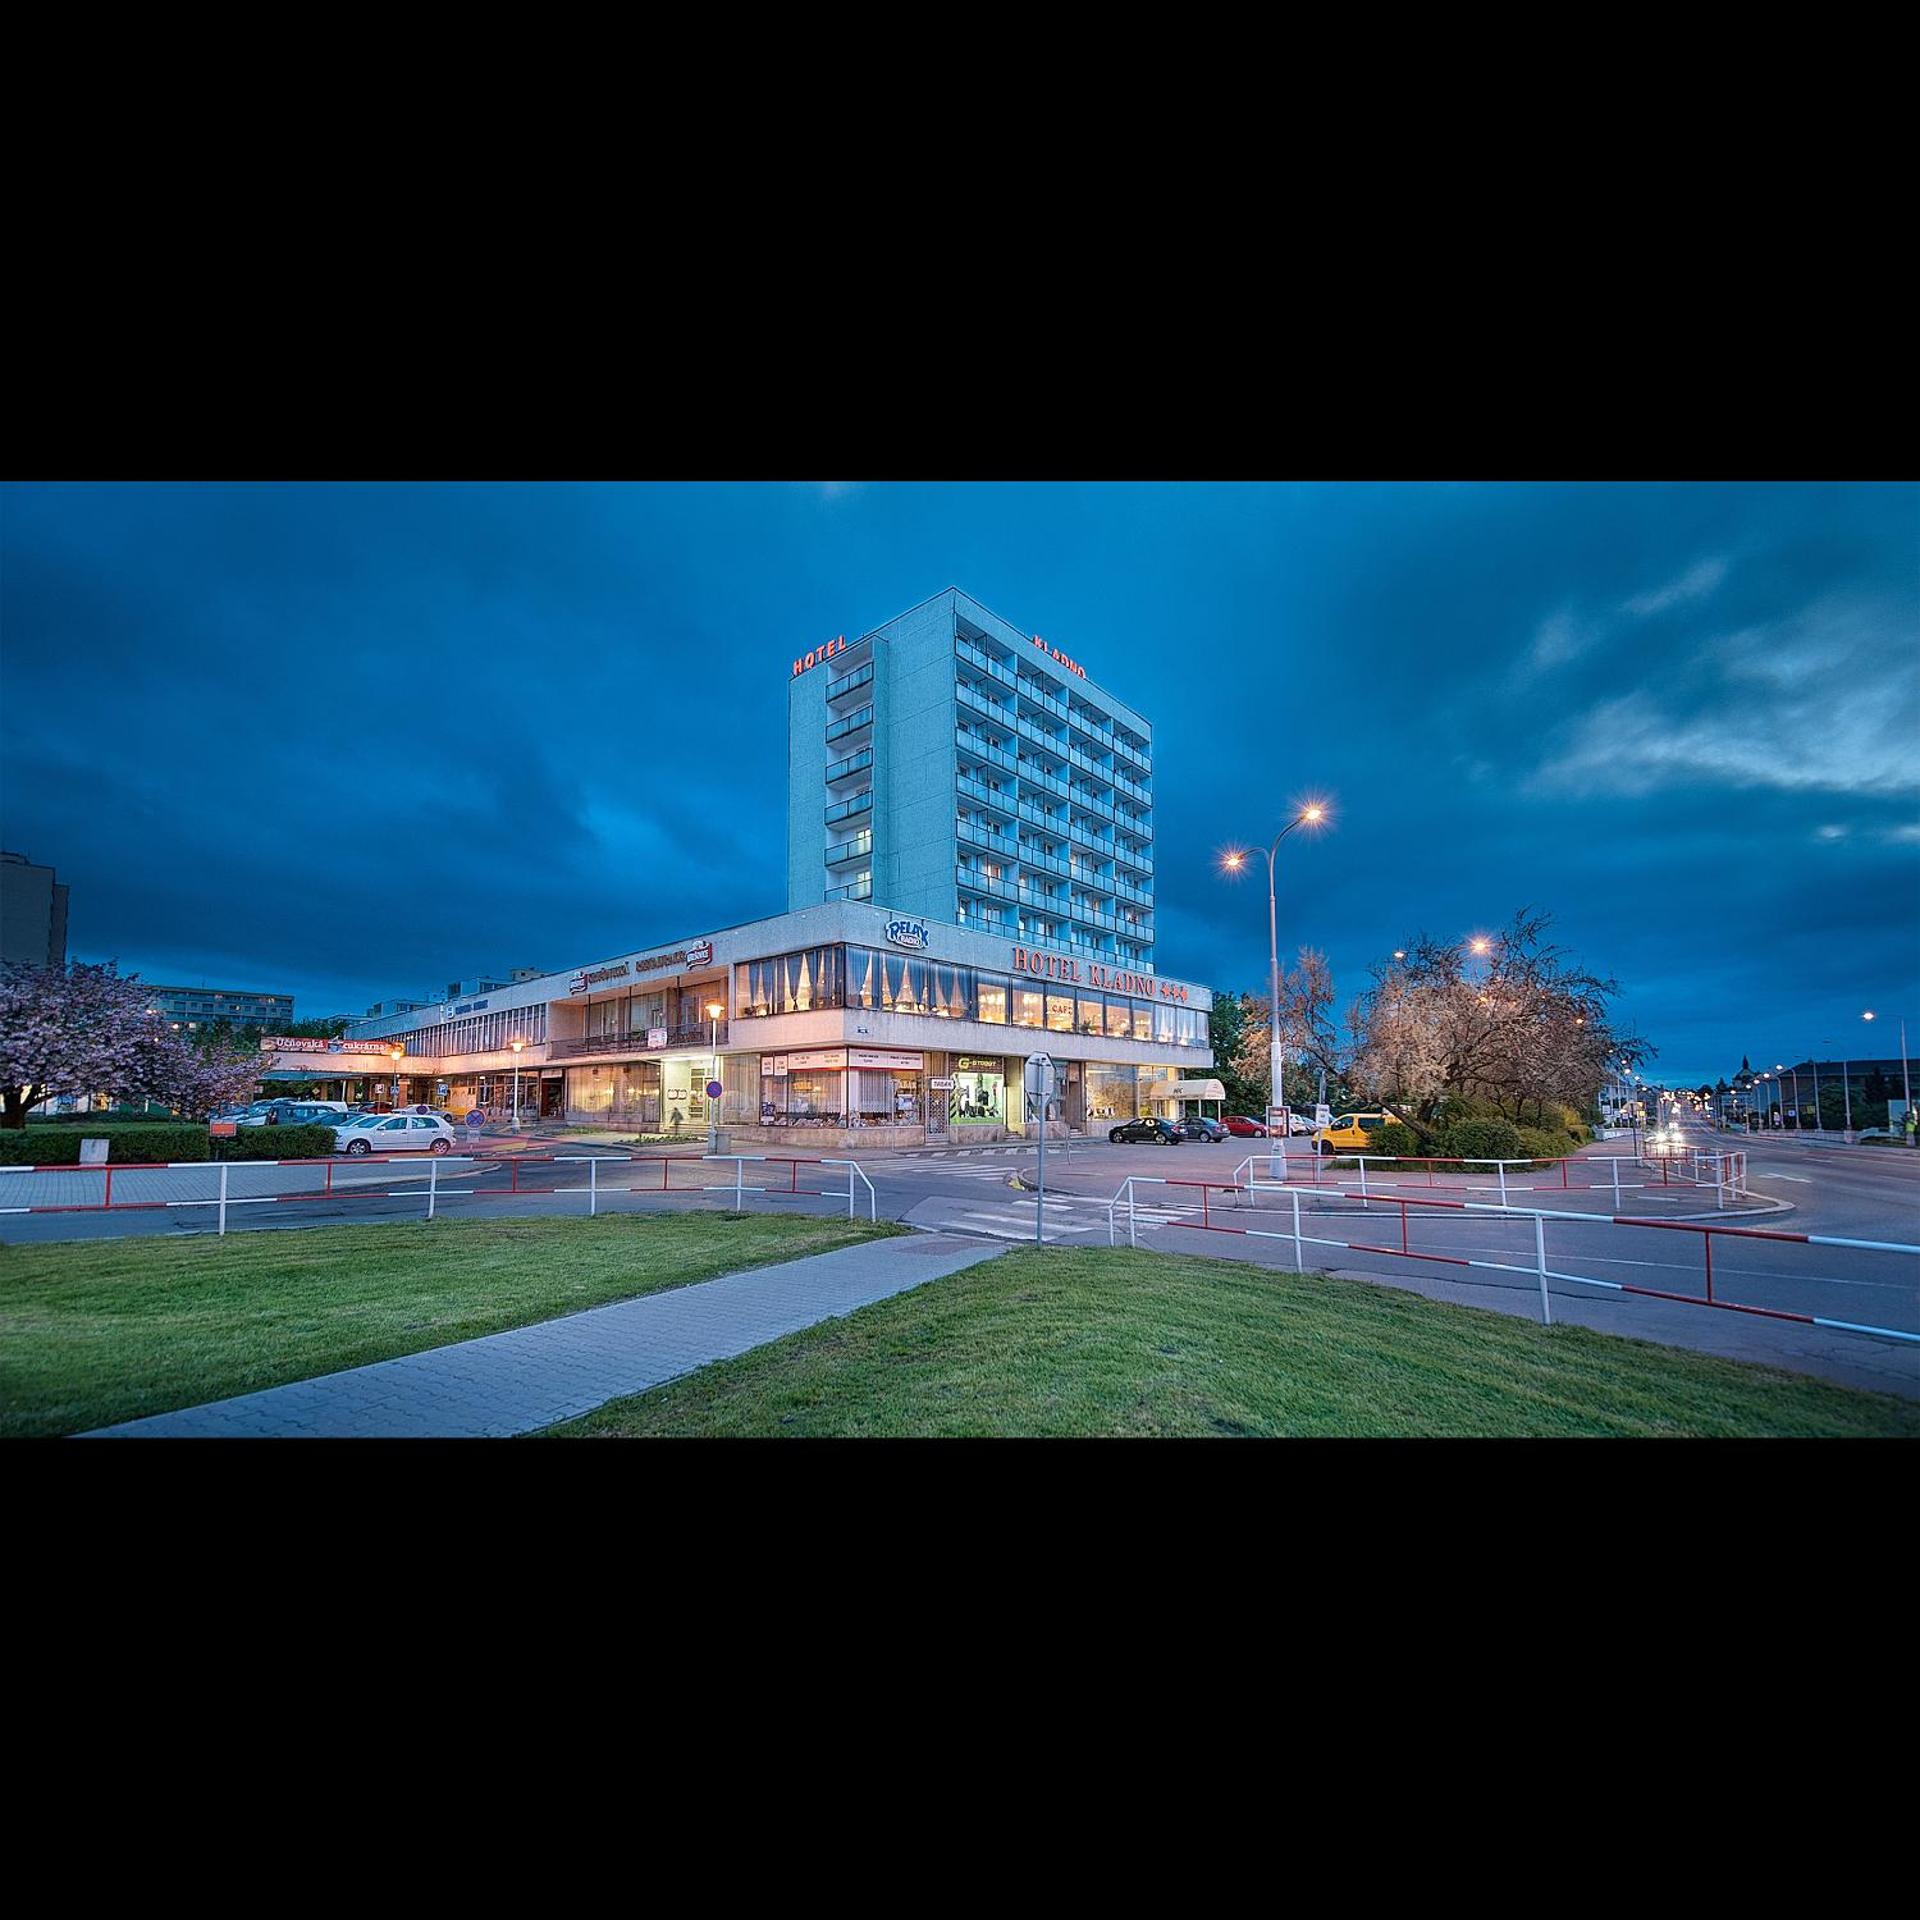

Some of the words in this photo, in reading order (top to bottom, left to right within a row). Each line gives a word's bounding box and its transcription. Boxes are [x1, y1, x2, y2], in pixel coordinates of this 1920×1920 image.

[793, 635, 847, 676] HOTEL
[888, 921, 929, 946] RELAX
[1013, 947, 1082, 981] HOTEL
[1089, 964, 1156, 997] KLADNO
